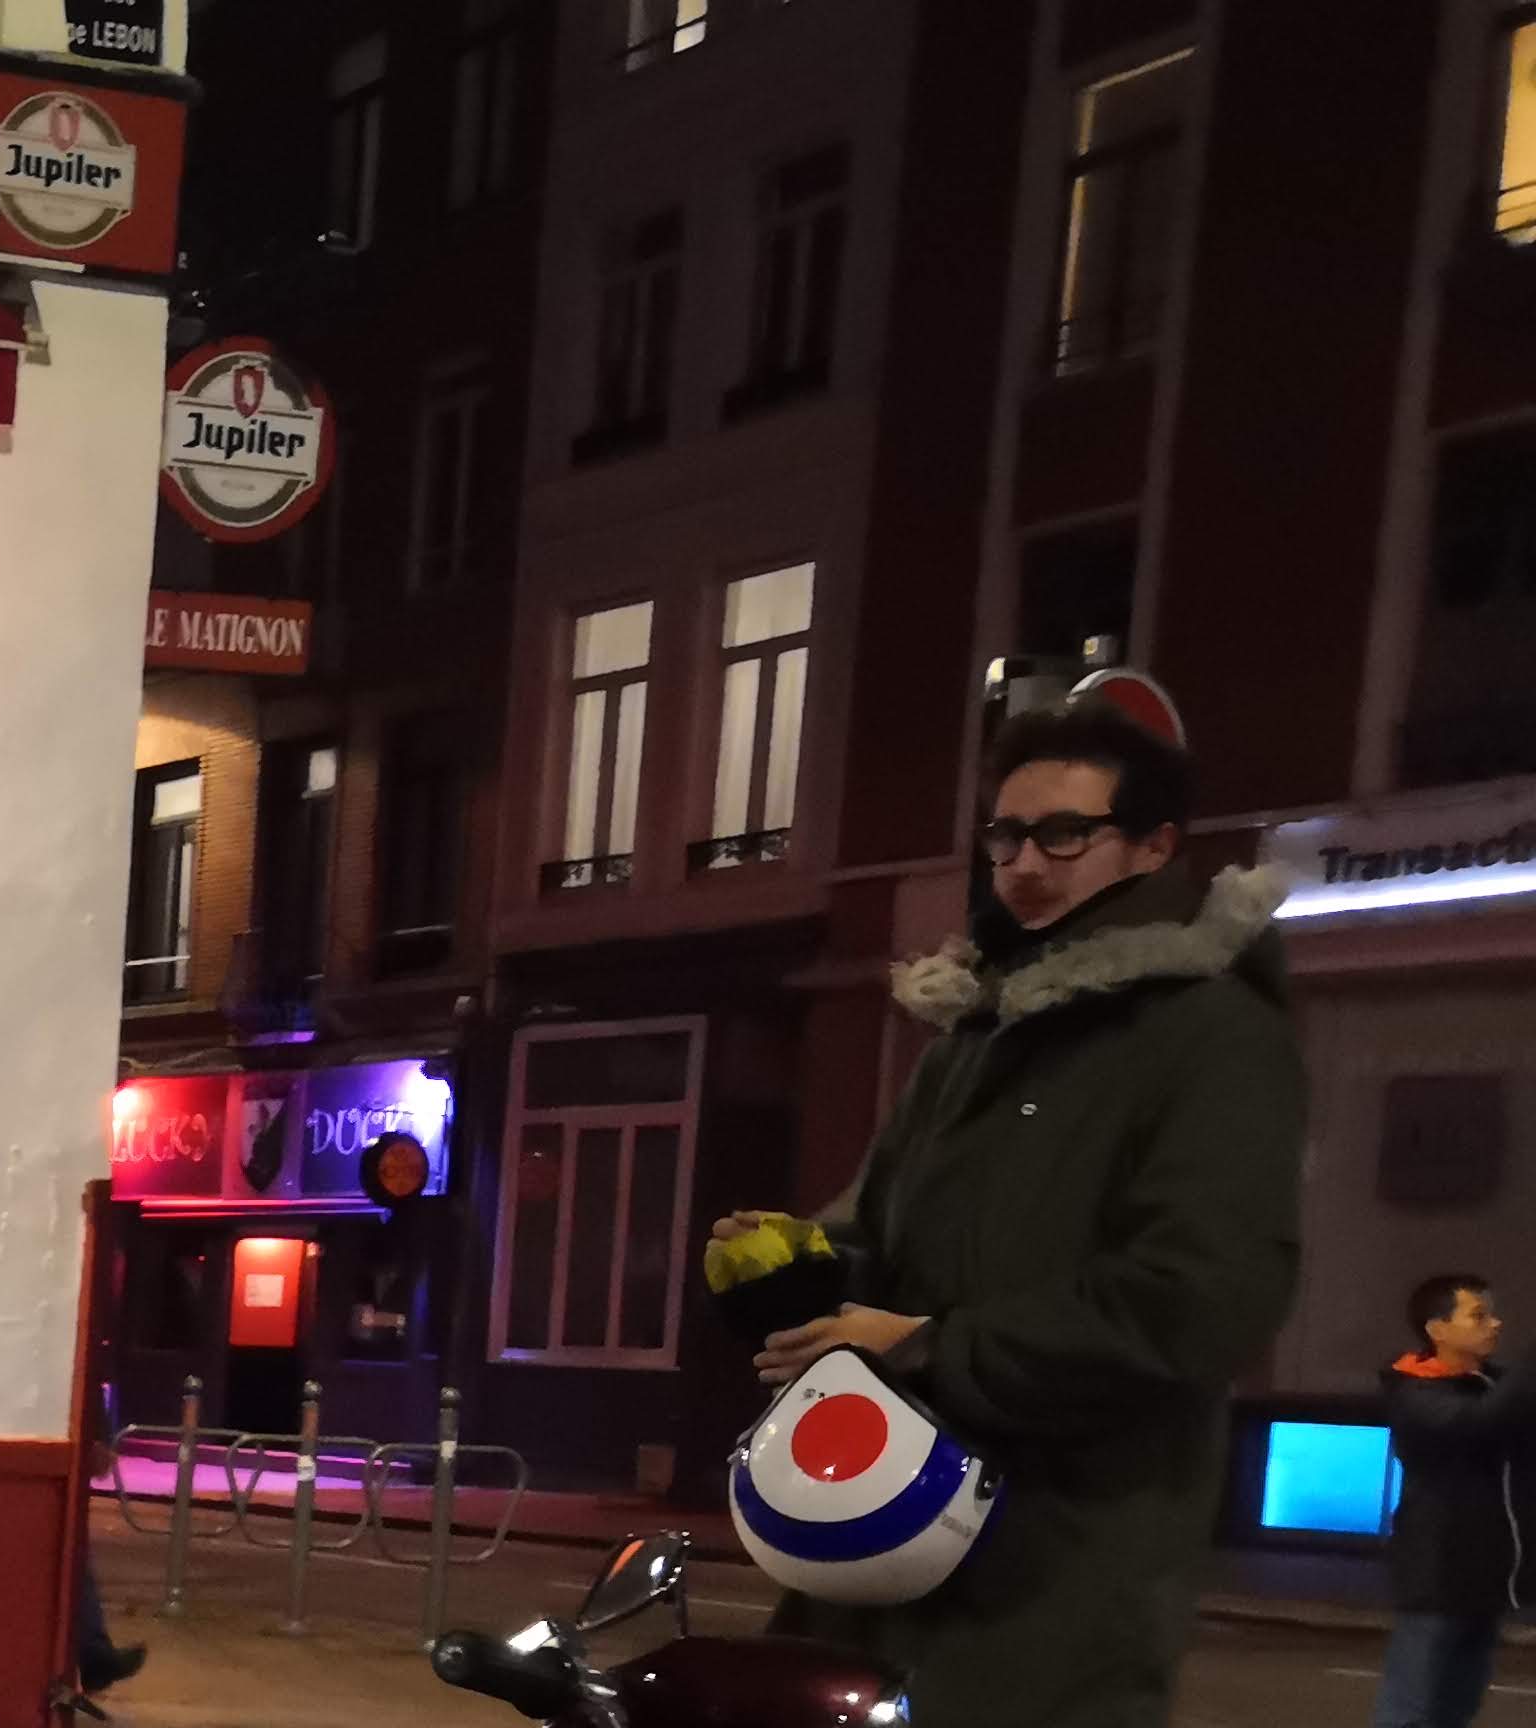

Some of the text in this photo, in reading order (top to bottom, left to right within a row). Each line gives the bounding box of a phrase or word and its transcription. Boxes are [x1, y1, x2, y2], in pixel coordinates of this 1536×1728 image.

[92, 20, 157, 54] LEBON
[5, 144, 121, 188] Jupiler
[182, 412, 306, 460] Jupiler
[180, 609, 306, 656] MATIGNON
